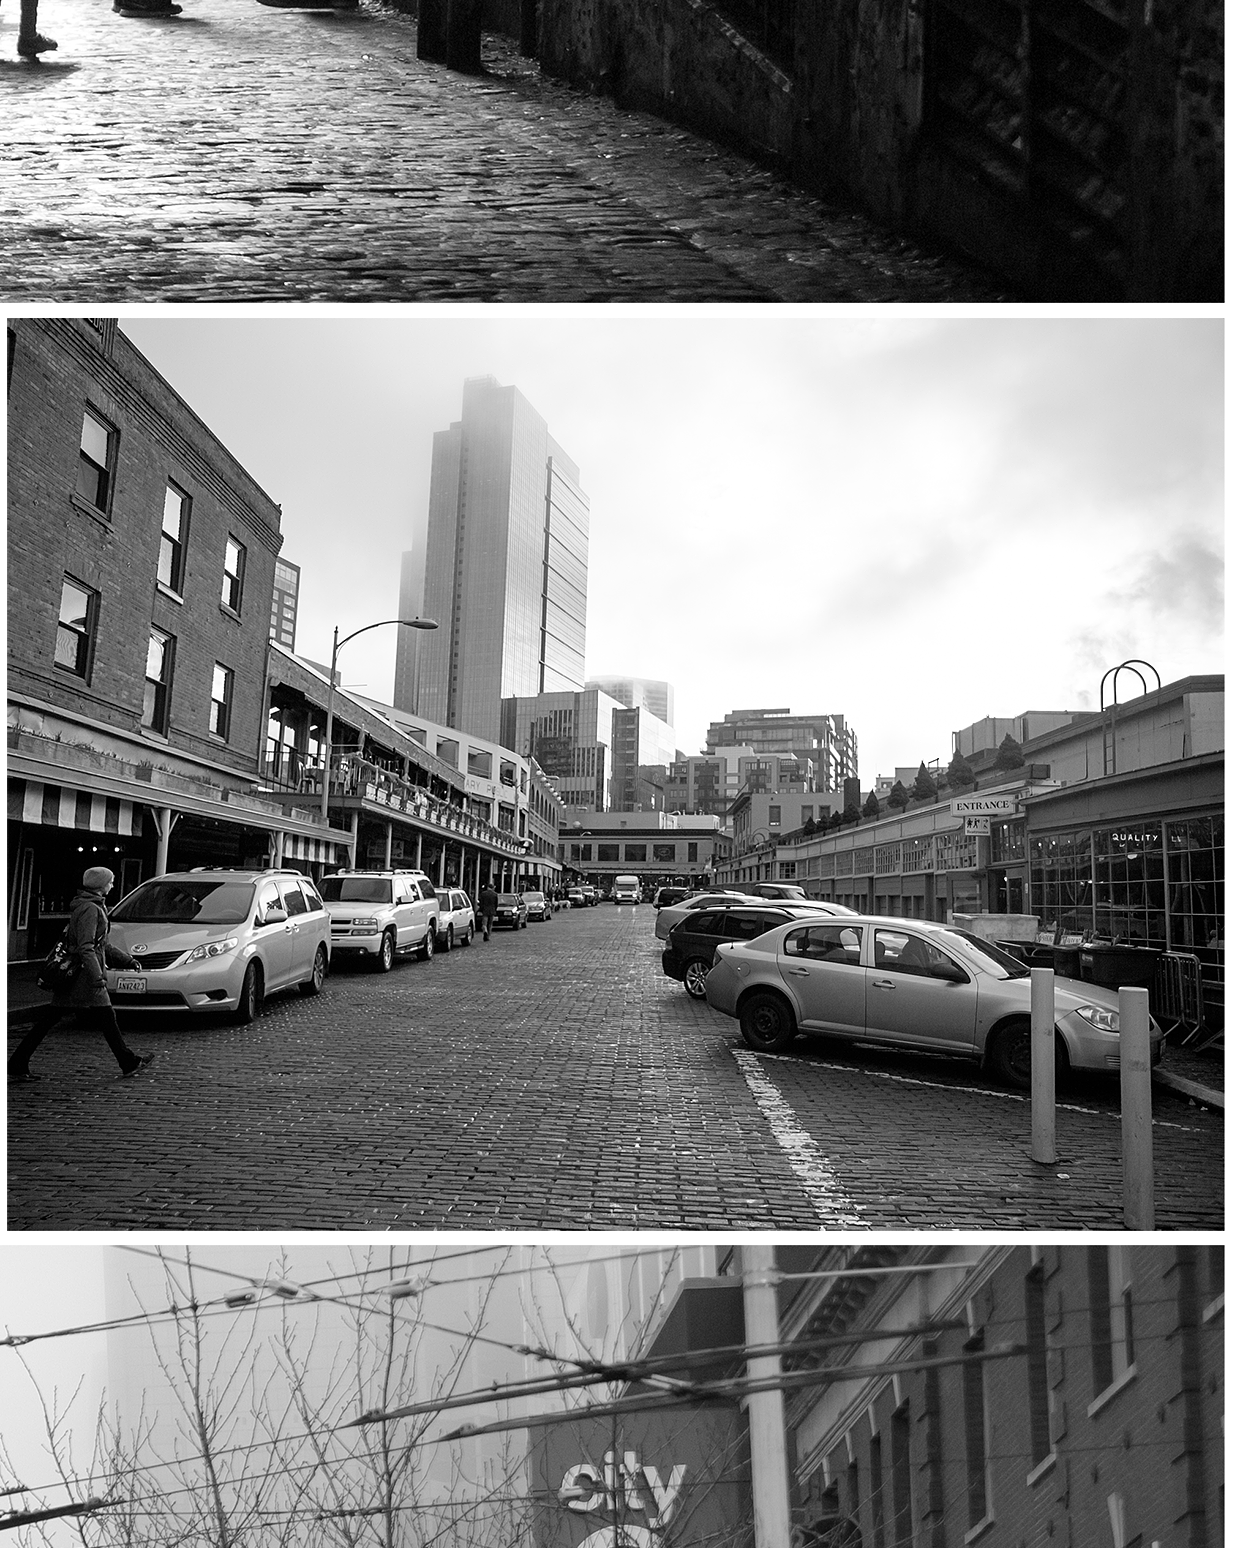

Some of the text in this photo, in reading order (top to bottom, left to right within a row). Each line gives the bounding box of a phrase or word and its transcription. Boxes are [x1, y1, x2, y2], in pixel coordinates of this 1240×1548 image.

[956, 800, 1010, 811] ENTRANCE
[1112, 833, 1158, 841] QUALITY
[560, 1451, 687, 1528] city
